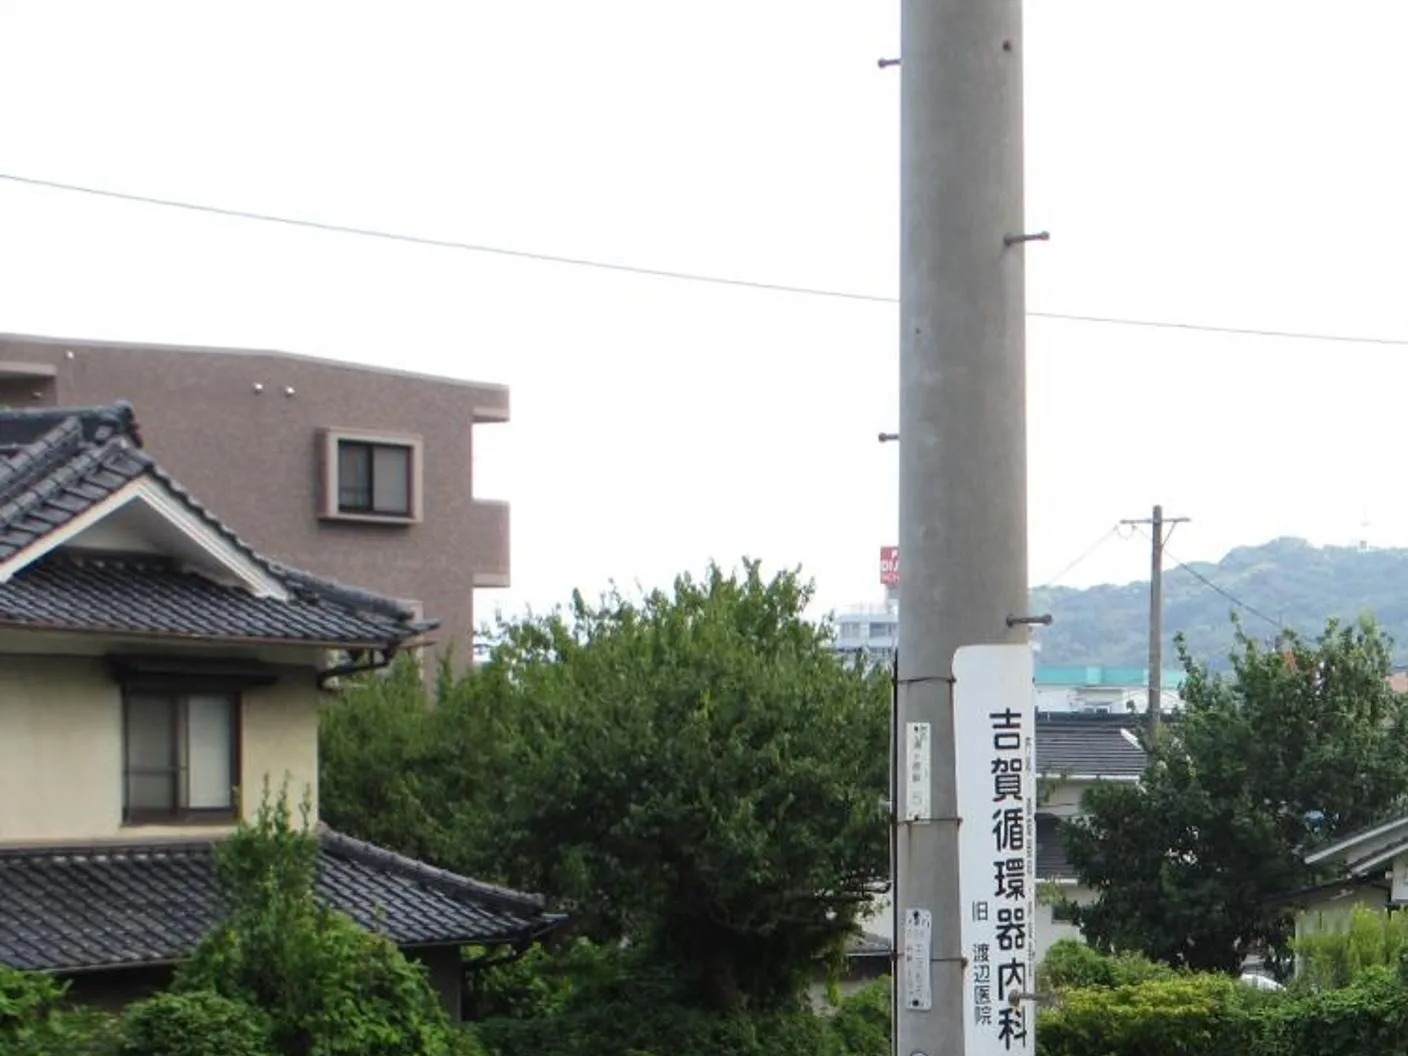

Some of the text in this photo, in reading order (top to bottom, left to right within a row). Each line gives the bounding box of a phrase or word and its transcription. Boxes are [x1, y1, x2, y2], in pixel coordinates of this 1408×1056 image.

[989, 708, 1028, 1050] 吉賀循環器内科
